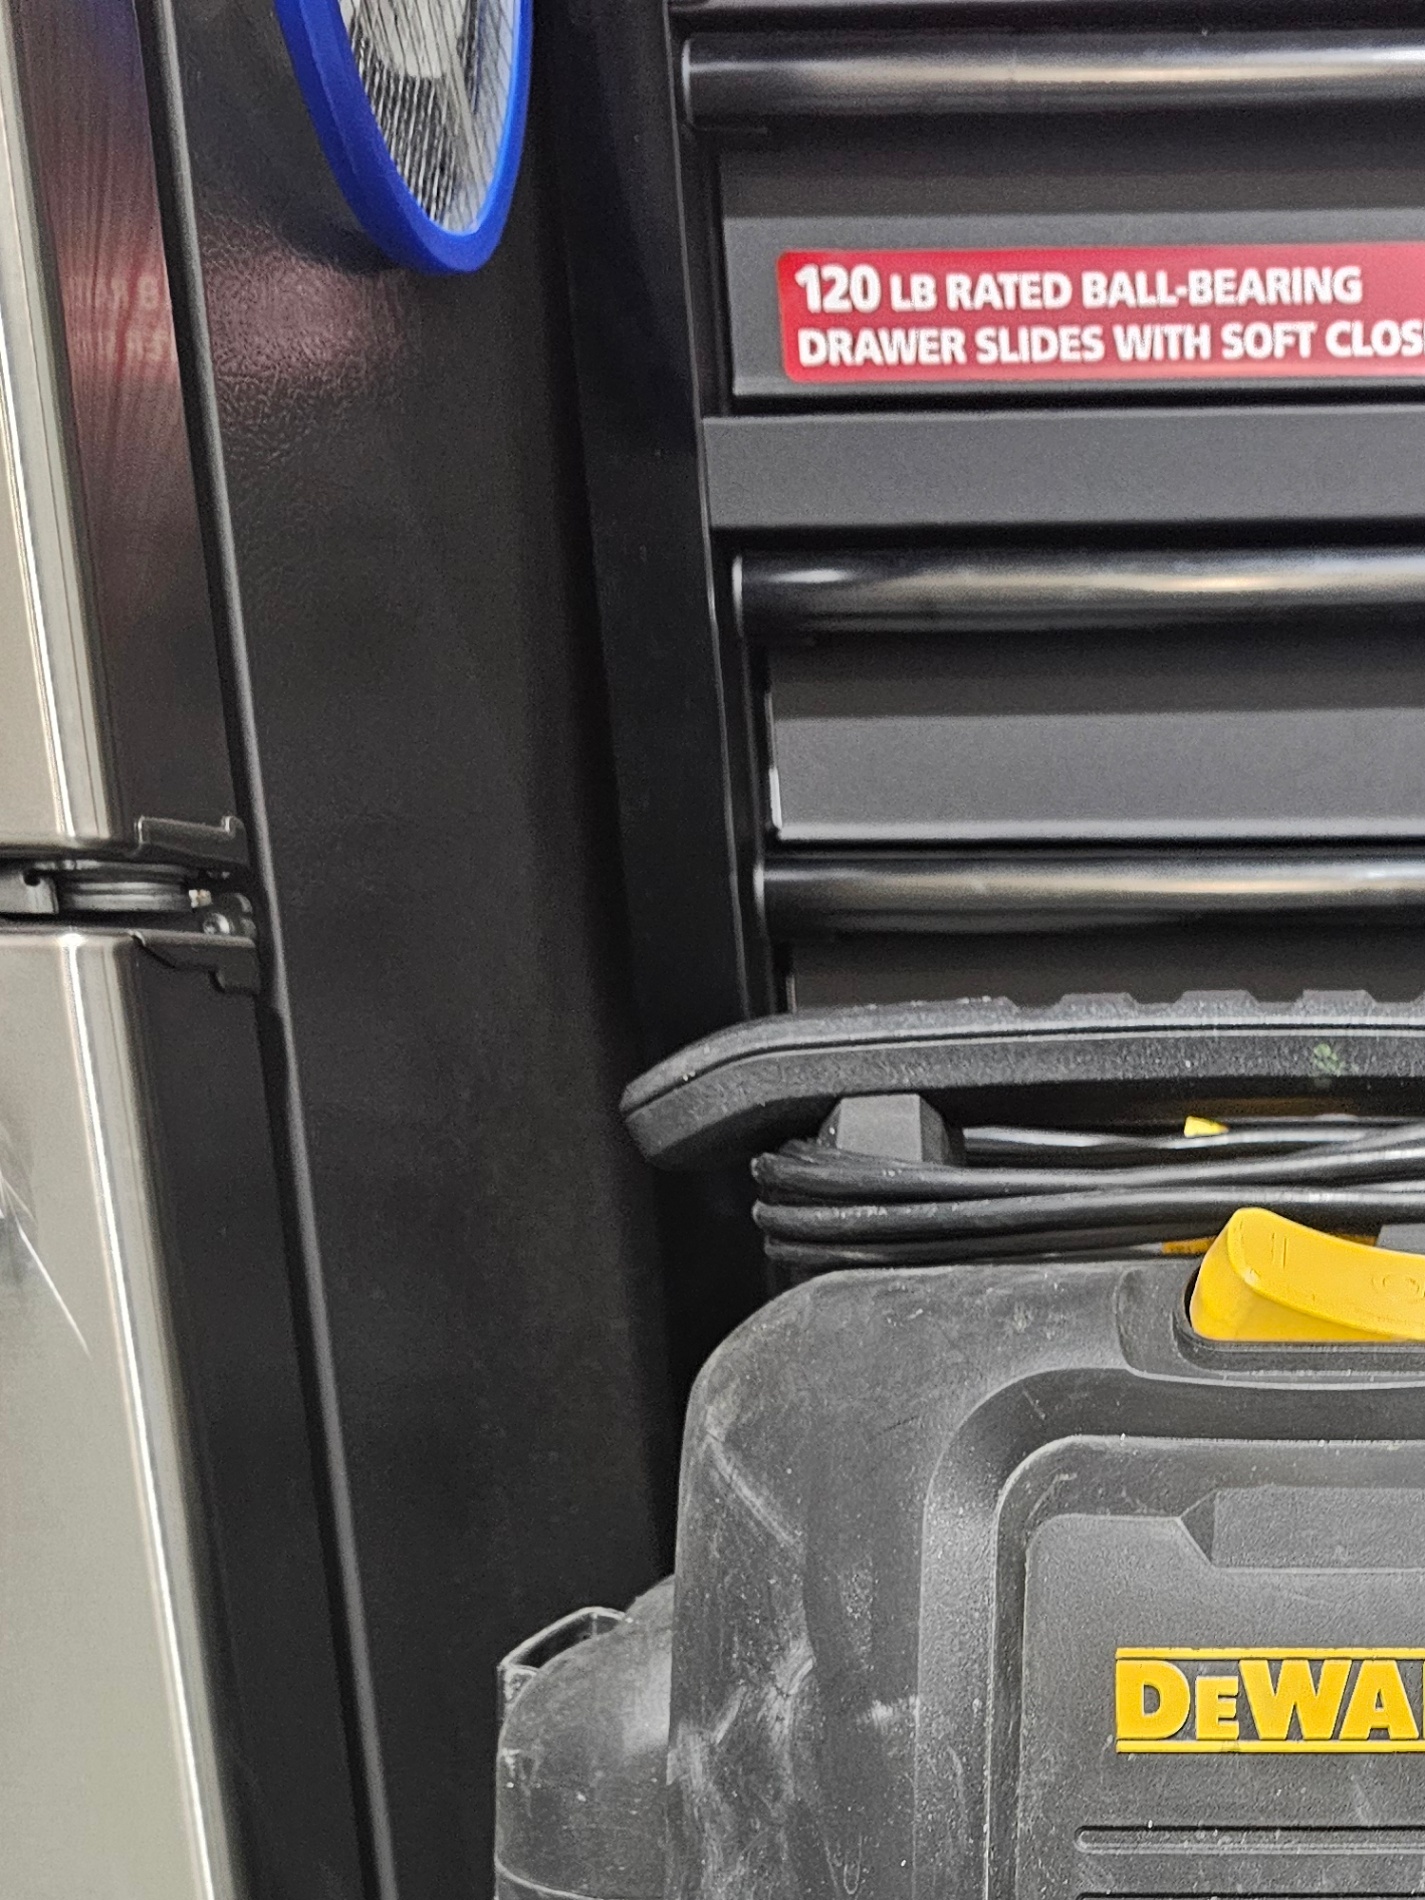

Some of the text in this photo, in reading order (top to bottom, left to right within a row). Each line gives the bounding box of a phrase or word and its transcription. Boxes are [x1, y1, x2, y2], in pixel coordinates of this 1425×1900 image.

[794, 264, 1363, 313] 120 LB RATED BALL-BEARING
[797, 326, 967, 366] DRAWER
[975, 324, 1104, 364] SLIDES
[1112, 322, 1211, 362] WITH
[1221, 320, 1318, 360] SOFT
